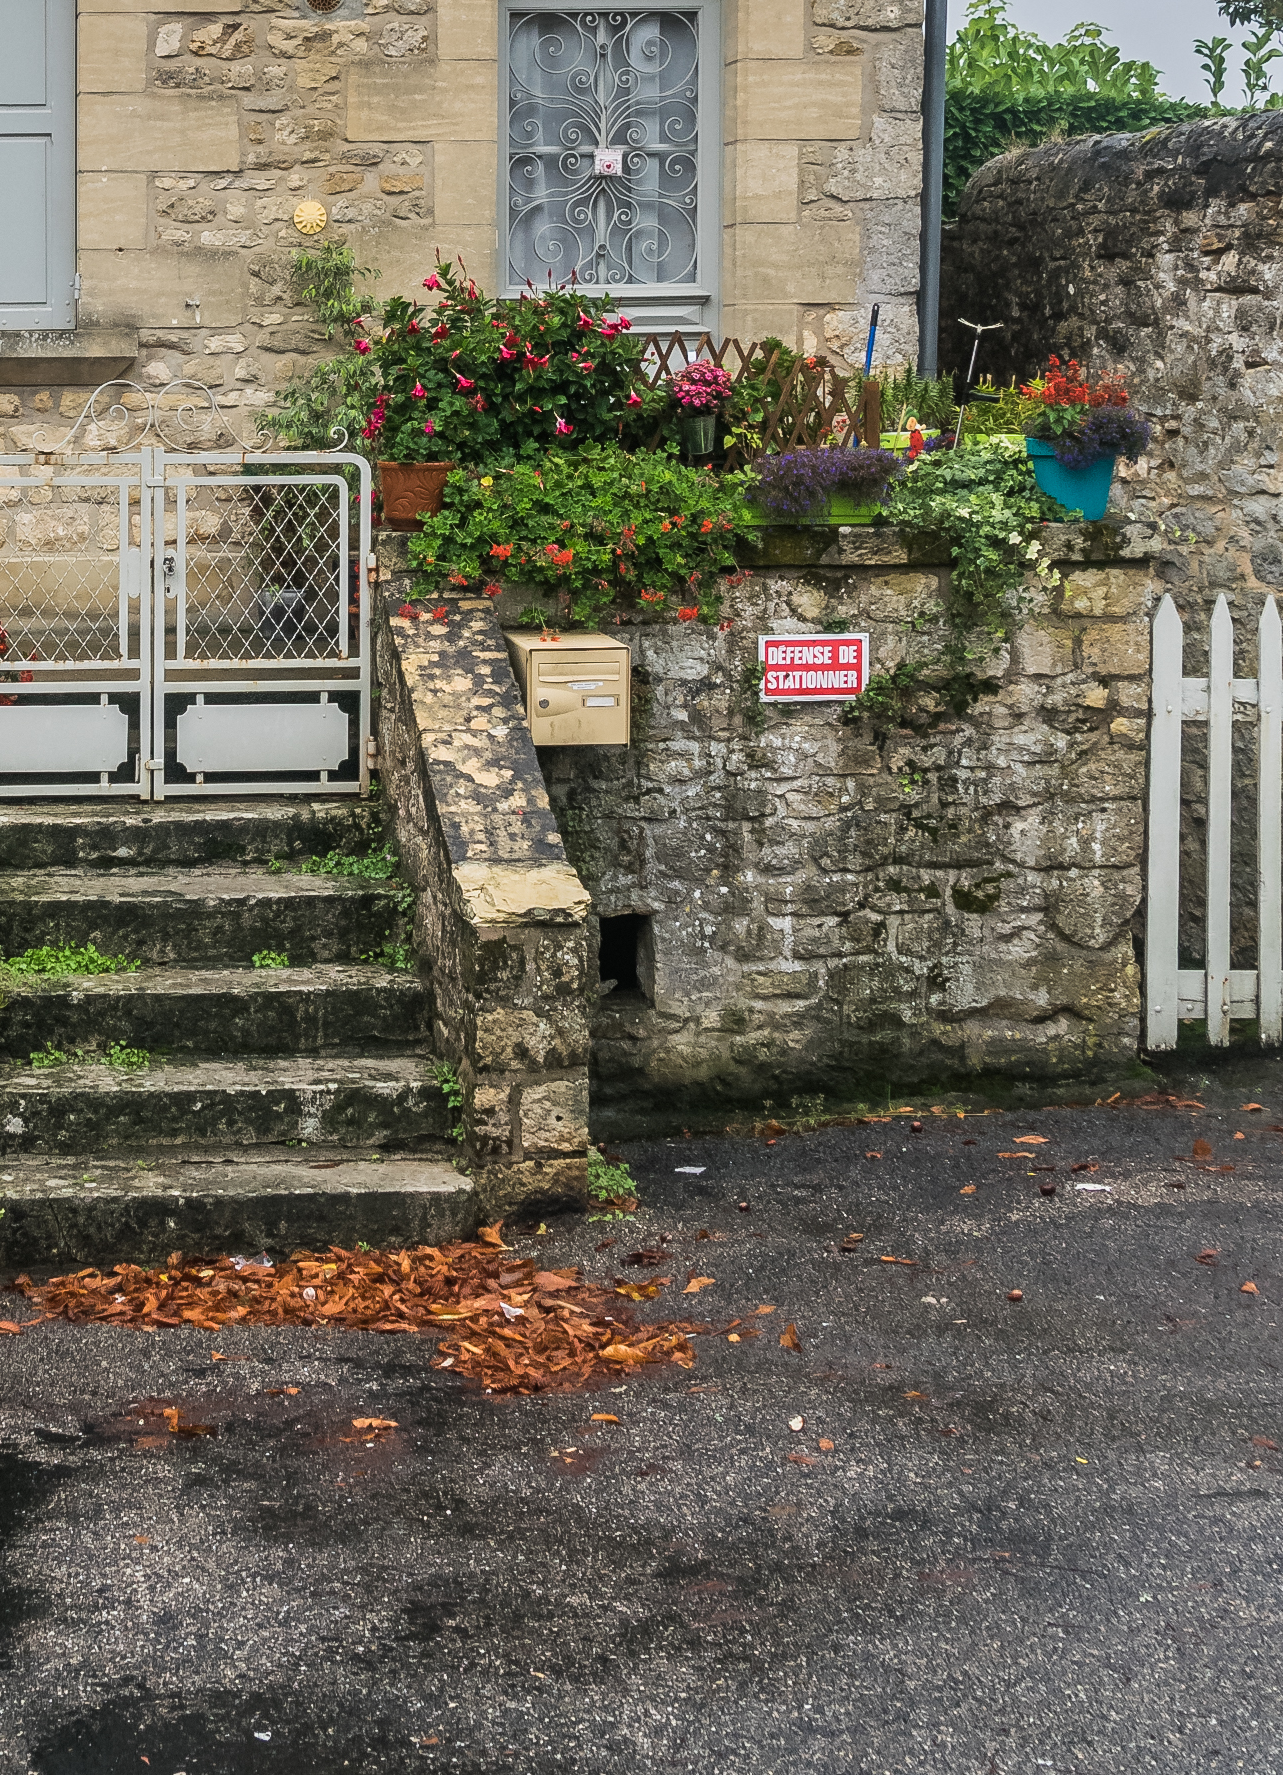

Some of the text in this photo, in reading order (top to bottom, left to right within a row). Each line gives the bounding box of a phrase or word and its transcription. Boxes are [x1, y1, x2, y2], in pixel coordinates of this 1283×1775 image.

[767, 644, 858, 665] DÉFENSE DE
[766, 670, 858, 690] STATIONNER
